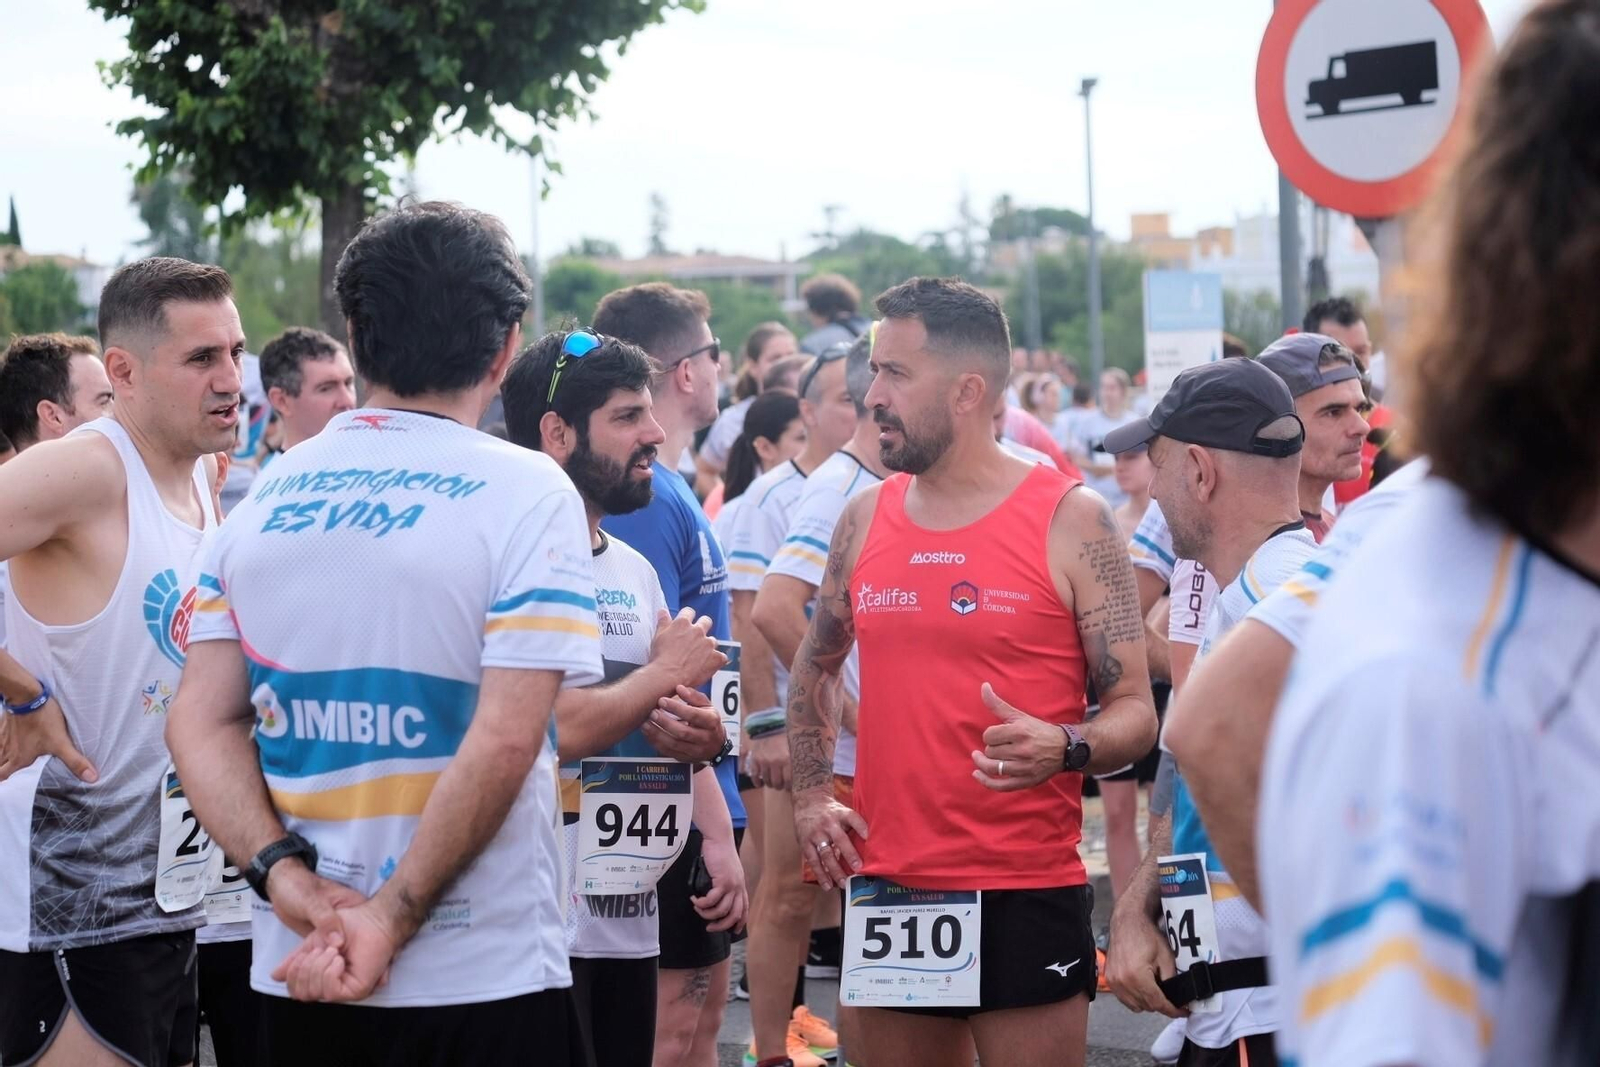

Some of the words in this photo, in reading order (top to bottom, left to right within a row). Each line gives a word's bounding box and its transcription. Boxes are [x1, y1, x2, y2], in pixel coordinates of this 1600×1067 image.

[254, 477, 281, 504] LA
[278, 468, 487, 500] INVESTIGACIÓN
[260, 500, 328, 533] ES
[324, 500, 425, 538] VIDA
[867, 588, 917, 607] califas
[983, 603, 1016, 614] CÓRDOBA
[984, 589, 1030, 601] UNIVERSIDAD
[291, 699, 427, 748] IMIBIC
[619, 773, 632, 782] POR
[641, 765, 669, 773] CARRERA
[596, 803, 679, 847] 944
[862, 914, 962, 960] 510
